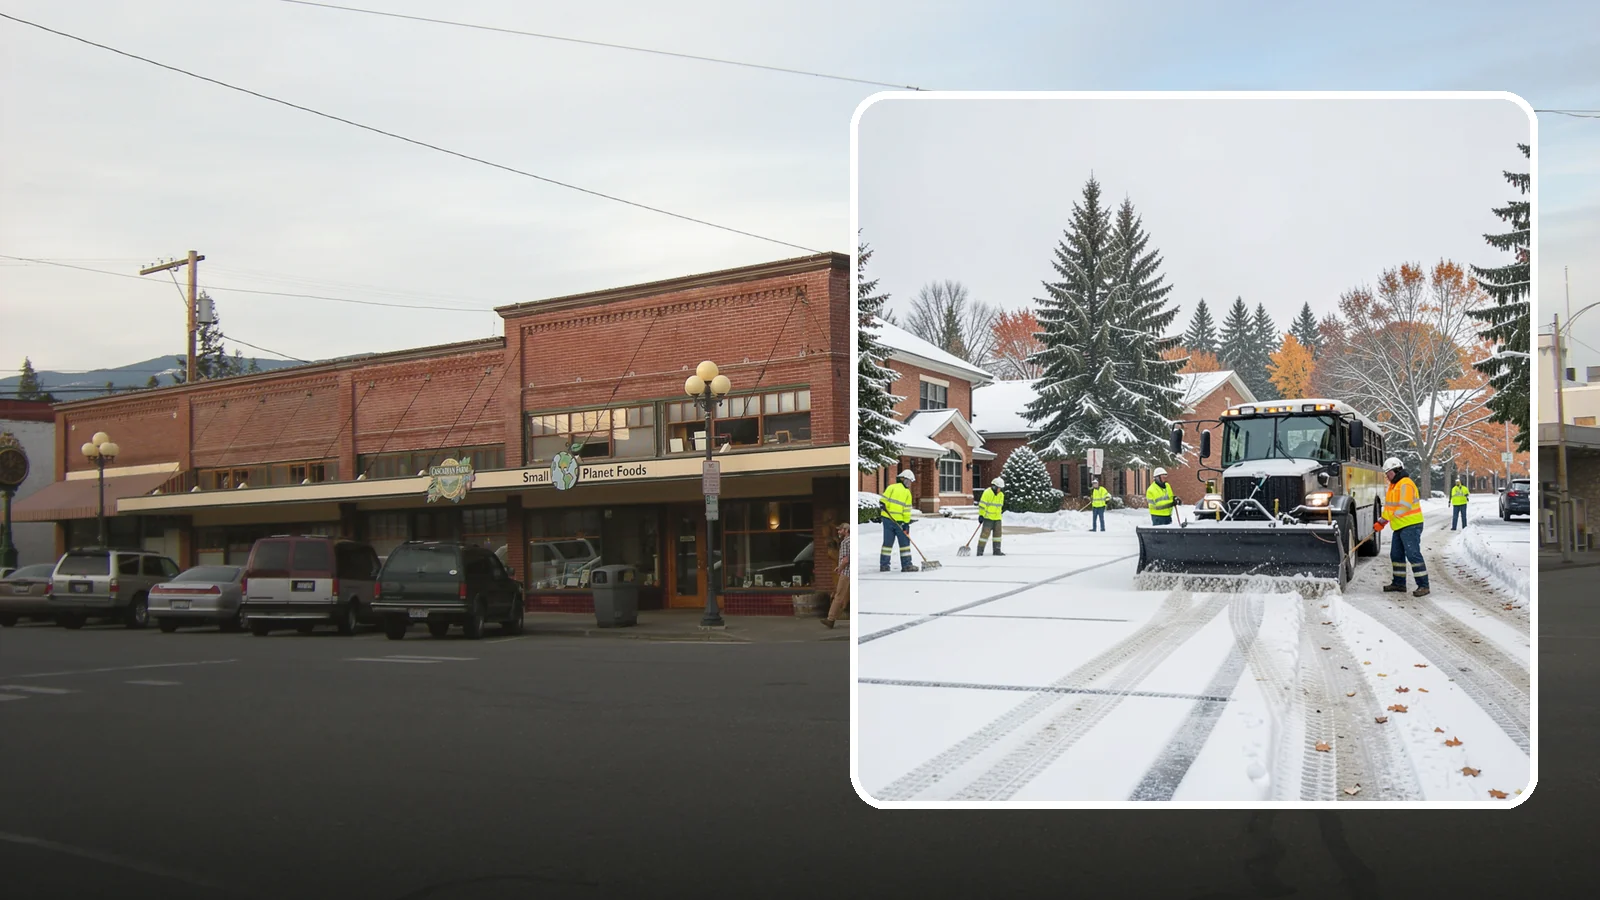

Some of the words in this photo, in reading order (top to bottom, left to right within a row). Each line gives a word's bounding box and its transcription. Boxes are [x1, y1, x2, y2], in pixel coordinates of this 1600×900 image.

[455, 466, 469, 474] FARM
[523, 471, 549, 483] Small
[582, 467, 614, 479] Planet
[616, 464, 647, 477] Foods
